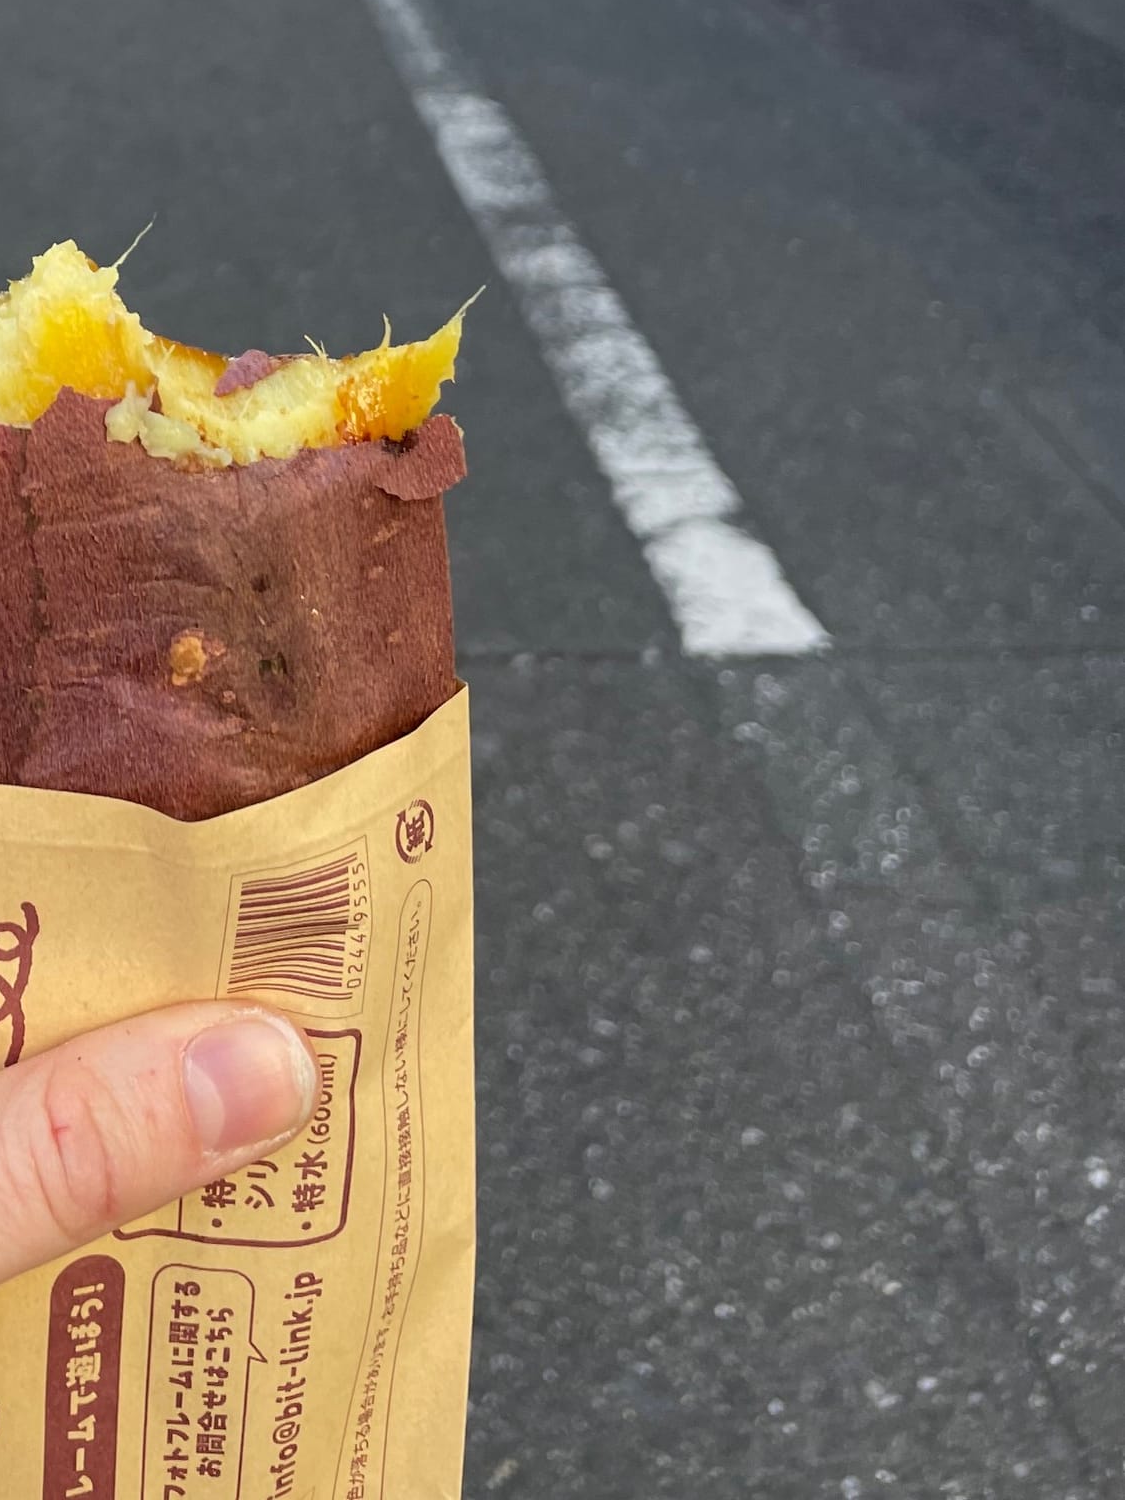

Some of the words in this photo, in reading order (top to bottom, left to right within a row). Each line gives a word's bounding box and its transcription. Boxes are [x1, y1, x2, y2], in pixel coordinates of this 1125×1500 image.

[163, 1280, 201, 1500] フォトフレームに関する
[195, 1307, 234, 1478] お問合せはこちら
[266, 1271, 323, 1500] info@bit-link.jp
